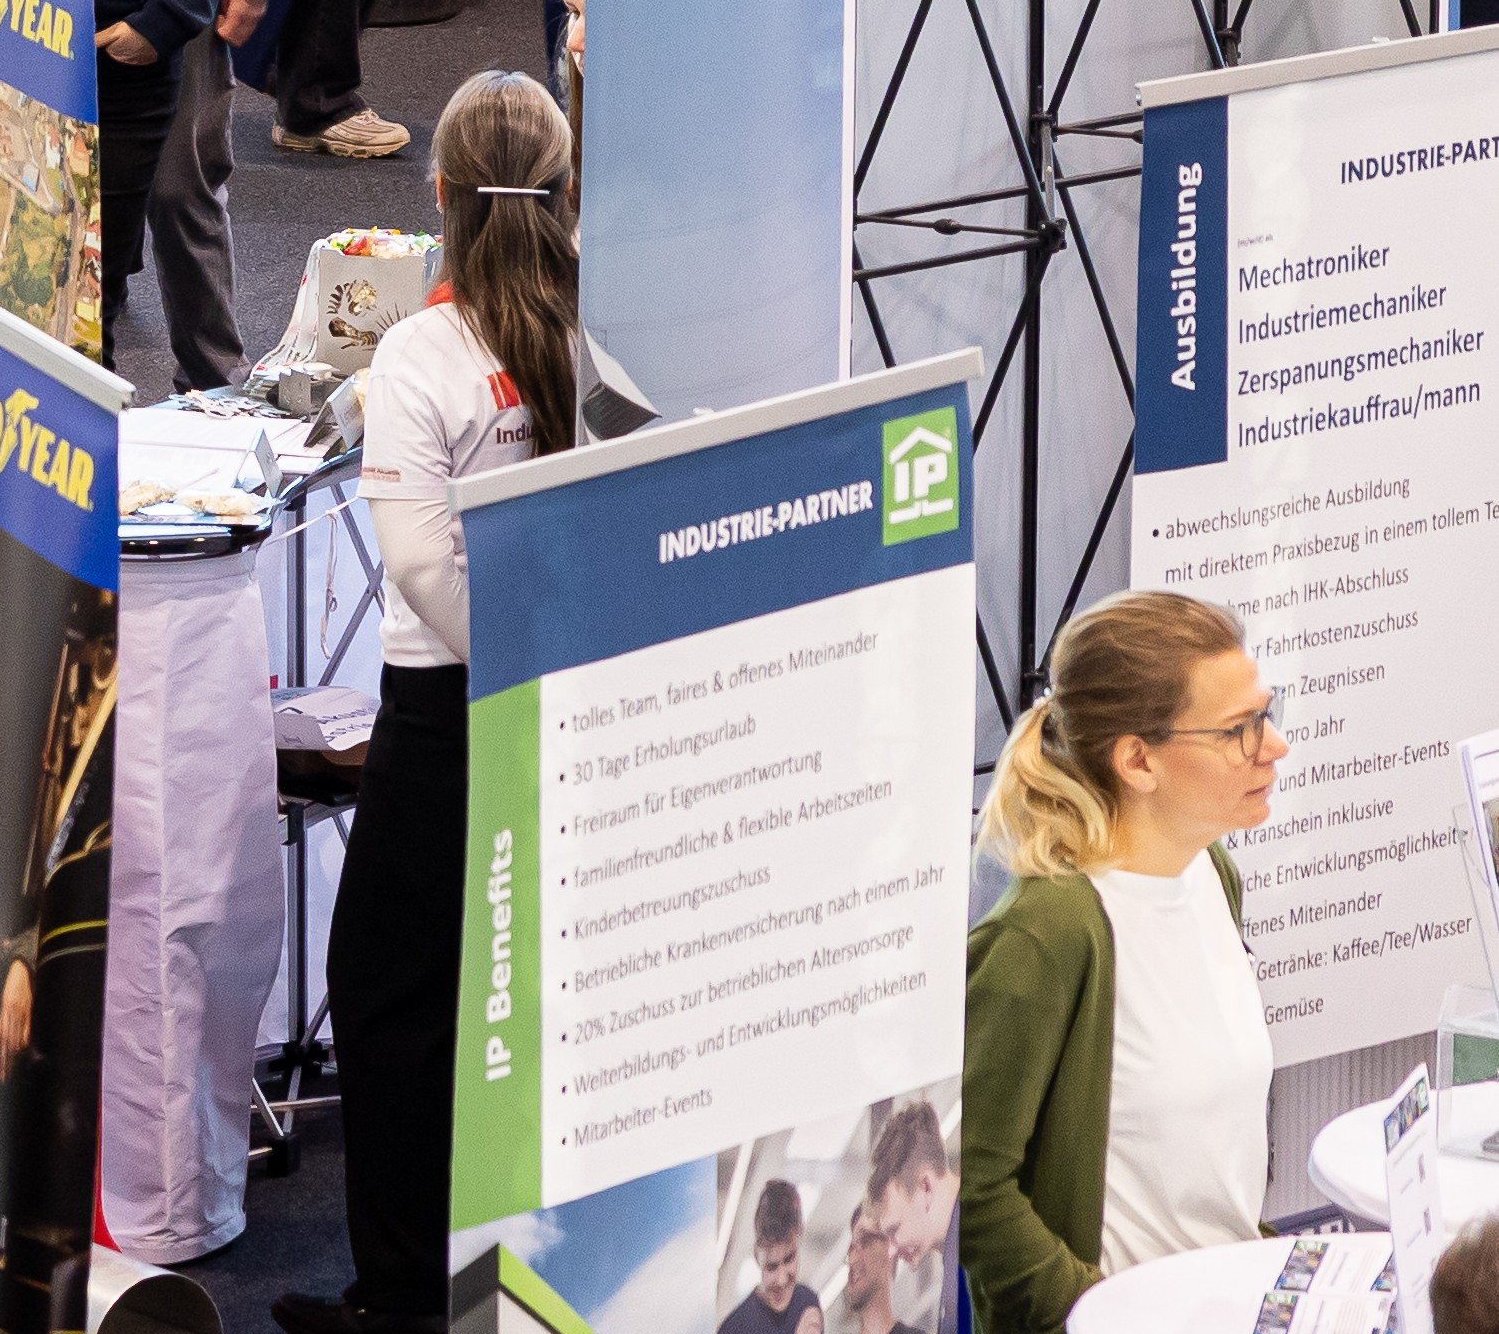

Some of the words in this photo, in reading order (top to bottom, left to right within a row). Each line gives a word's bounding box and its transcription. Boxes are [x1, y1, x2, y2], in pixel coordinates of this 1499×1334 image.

[1171, 161, 1203, 391] Ausbildung
[1238, 242, 1390, 294] Mechatroniker
[1238, 283, 1447, 345] Industriemechaniker
[1238, 328, 1485, 398] Zerspanungsmechaniker
[1238, 380, 1481, 448] Industriekauffrau/mann
[660, 481, 873, 565] INDUSTRIE-PARTNER
[1265, 608, 1419, 661] Fahrtkostenzuschuss
[572, 706, 614, 735] tolles
[619, 694, 661, 721] Team,
[667, 676, 708, 706] faires
[712, 670, 724, 693] &
[728, 658, 784, 691] offenes
[788, 629, 879, 675] Miteinander
[1311, 738, 1450, 787] Mitarbeiter-Events
[485, 828, 513, 1023] Benefits
[1256, 945, 1329, 983] Getränke:
[1332, 912, 1473, 966] Kaffee/Tee/Wasser
[485, 1036, 512, 1081] IP
